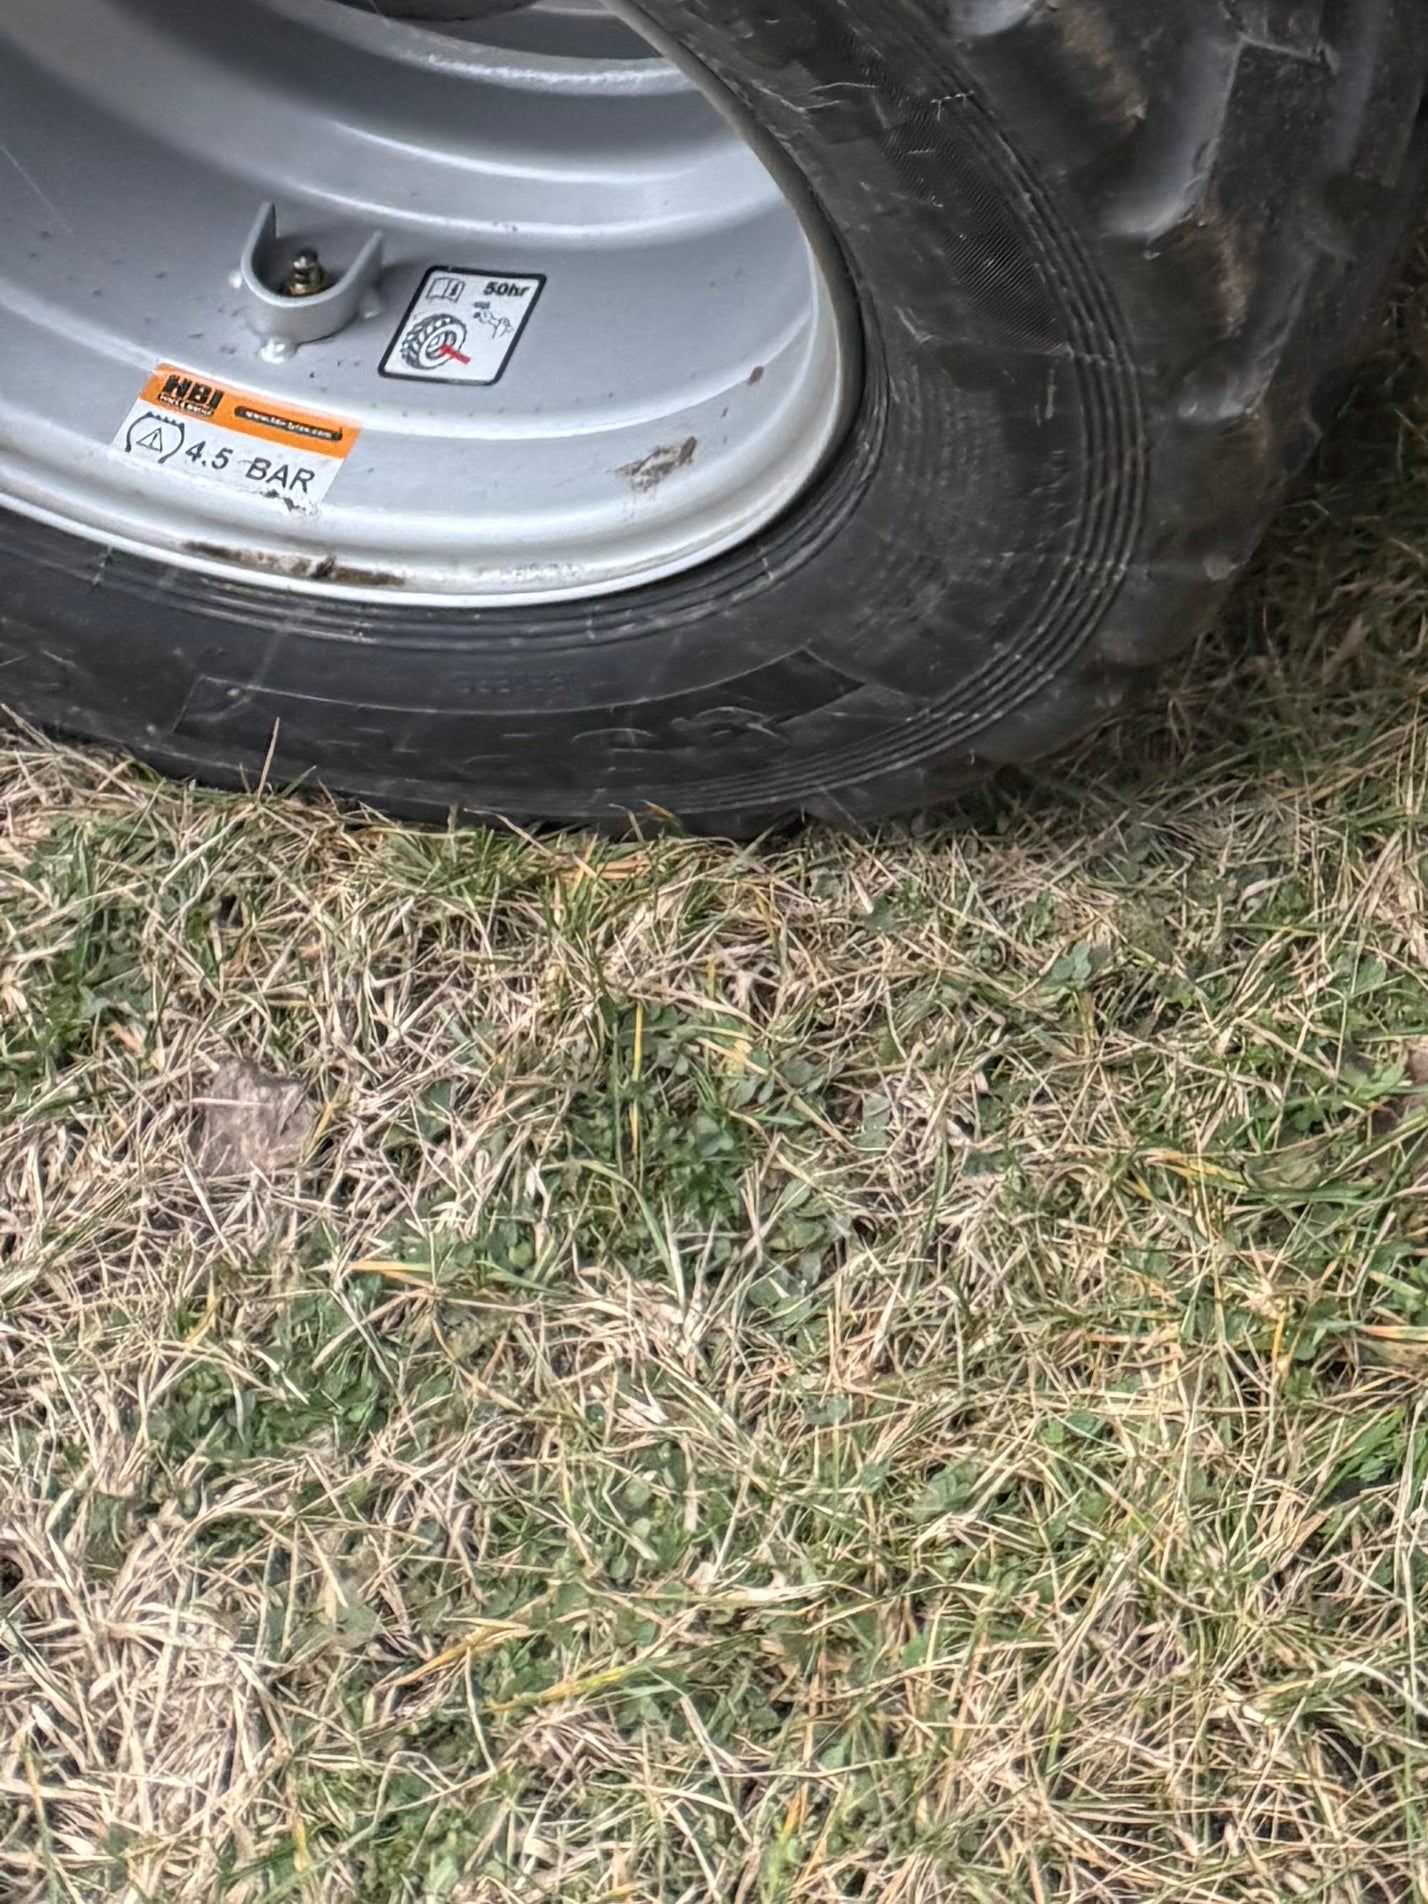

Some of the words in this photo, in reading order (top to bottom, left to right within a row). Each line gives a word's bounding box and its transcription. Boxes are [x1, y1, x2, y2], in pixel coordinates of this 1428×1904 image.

[482, 280, 532, 298] 50hr
[184, 439, 233, 470] 4.5
[245, 456, 316, 494] BAR
